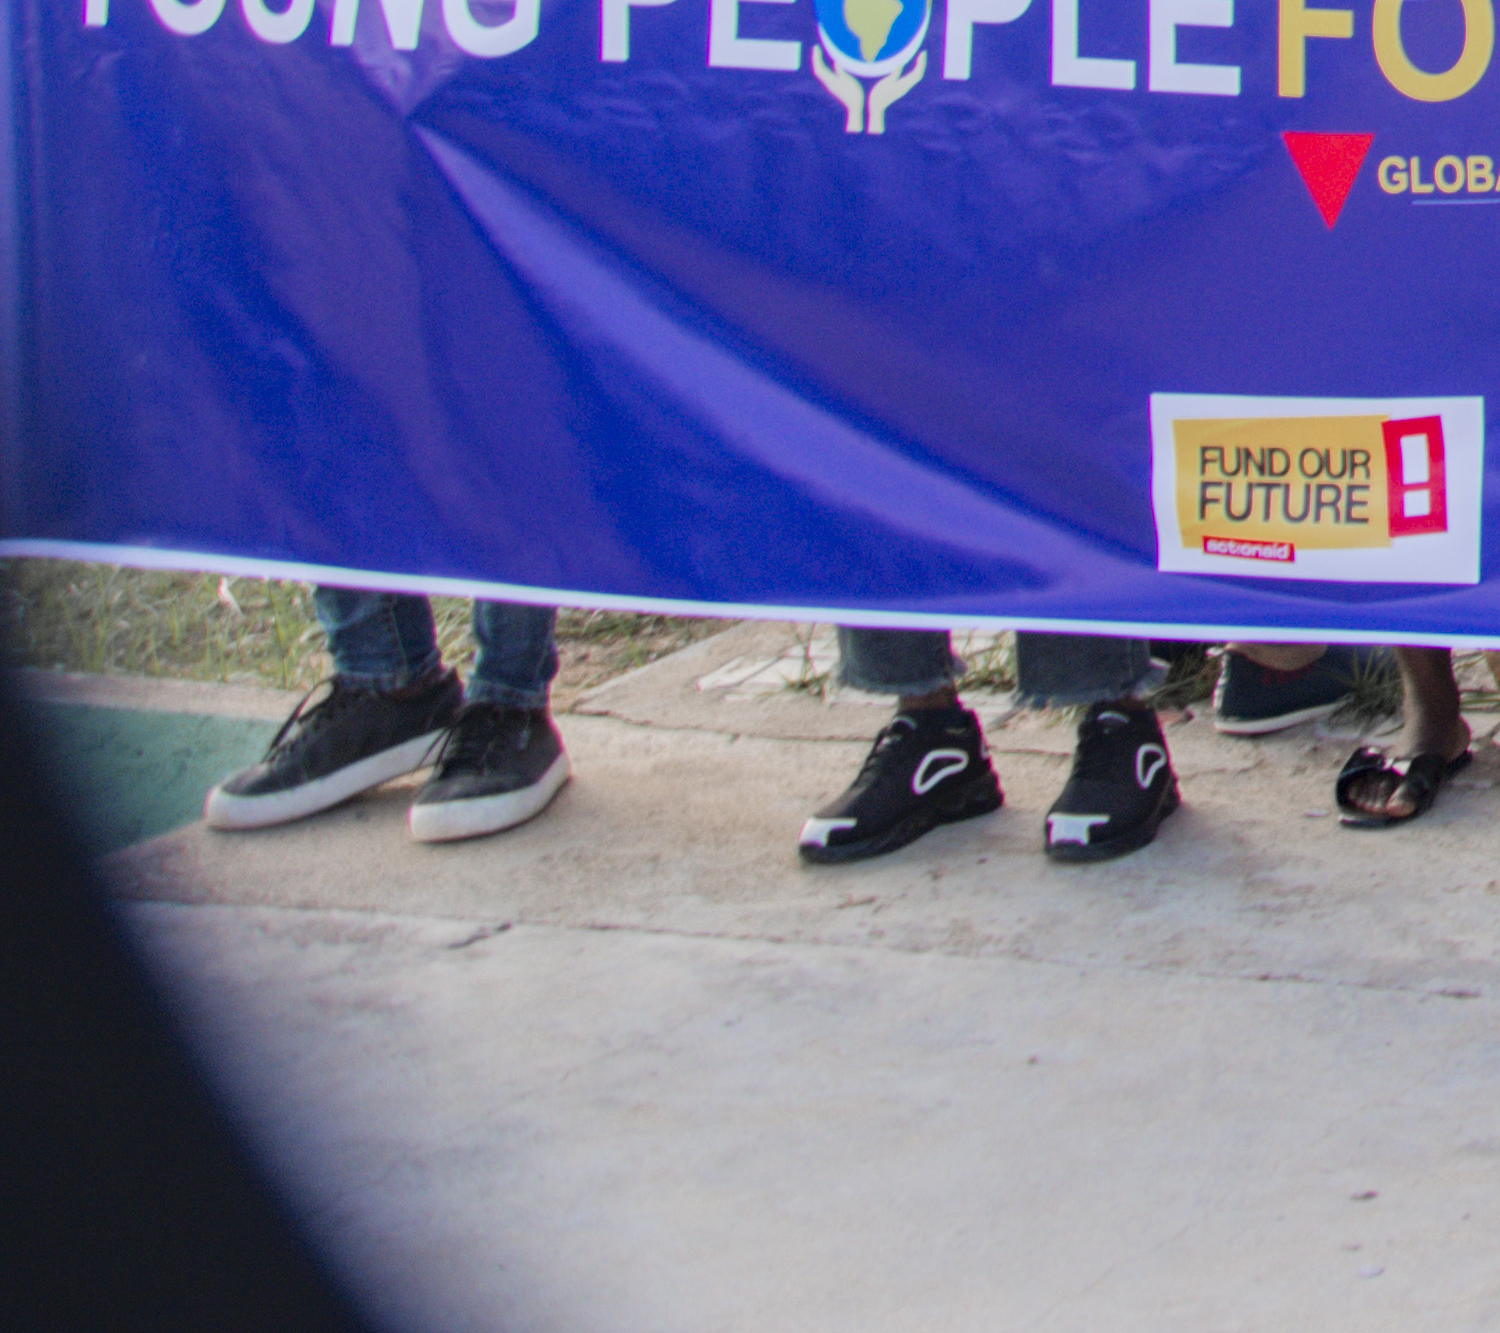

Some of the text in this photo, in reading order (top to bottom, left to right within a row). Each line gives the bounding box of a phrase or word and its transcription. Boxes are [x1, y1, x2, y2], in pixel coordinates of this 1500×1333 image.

[1199, 445, 1371, 480] FUND OUR
[1198, 481, 1371, 525] FUTURE
